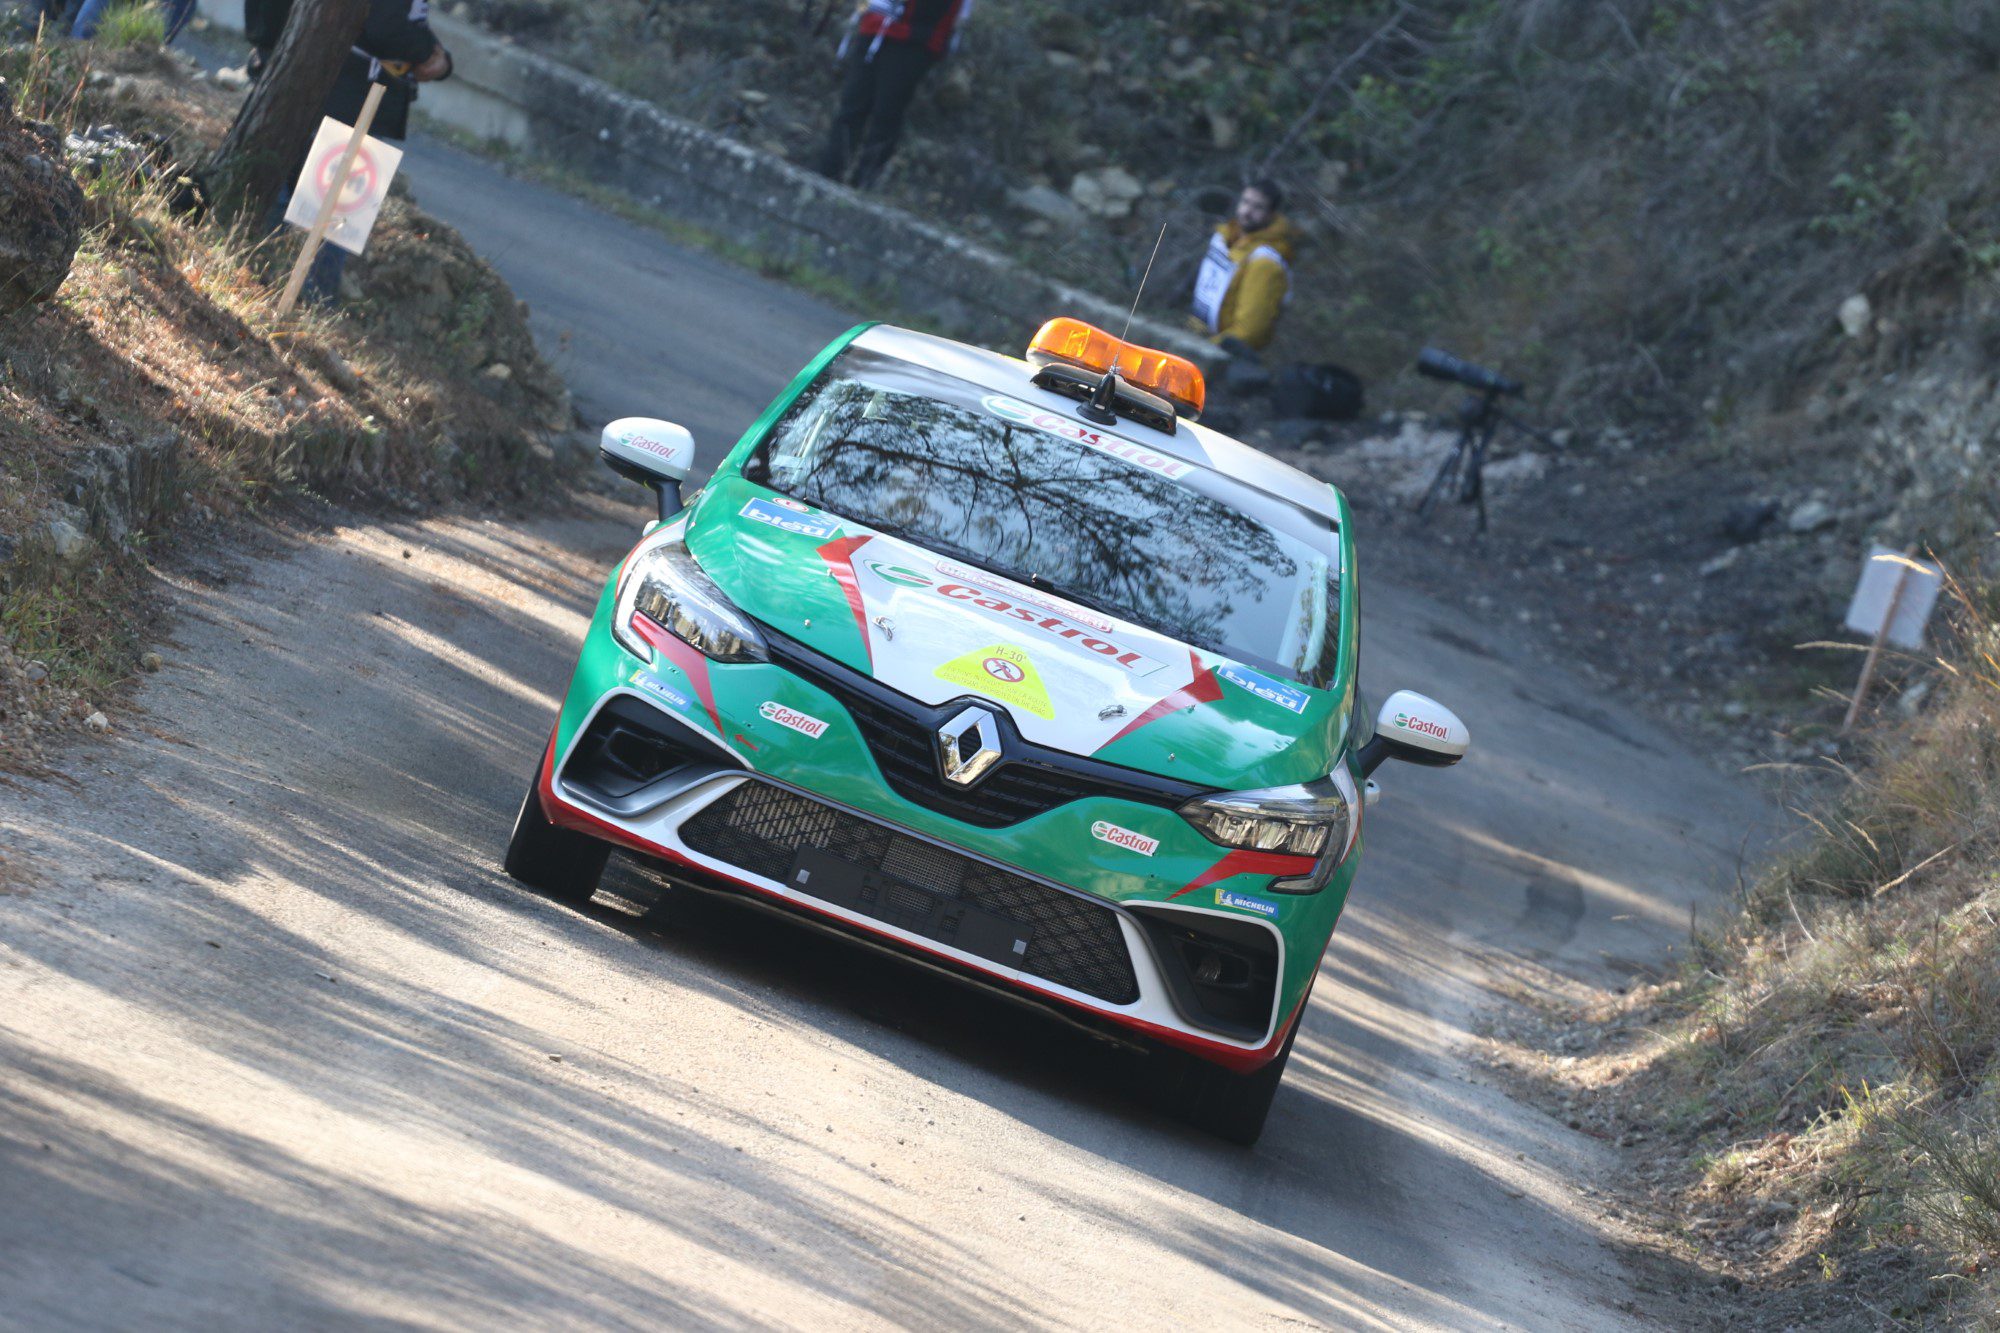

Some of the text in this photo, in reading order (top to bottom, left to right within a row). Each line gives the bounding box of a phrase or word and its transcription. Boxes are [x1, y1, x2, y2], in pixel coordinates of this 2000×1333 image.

[631, 436, 676, 458] Castrol
[1033, 414, 1182, 477] Castrol
[937, 584, 1142, 668] Castrol
[773, 708, 825, 735] Castrol
[1408, 716, 1448, 738] Castrol
[1107, 827, 1155, 854] Castrol
[1234, 898, 1275, 914] MICHELIN
